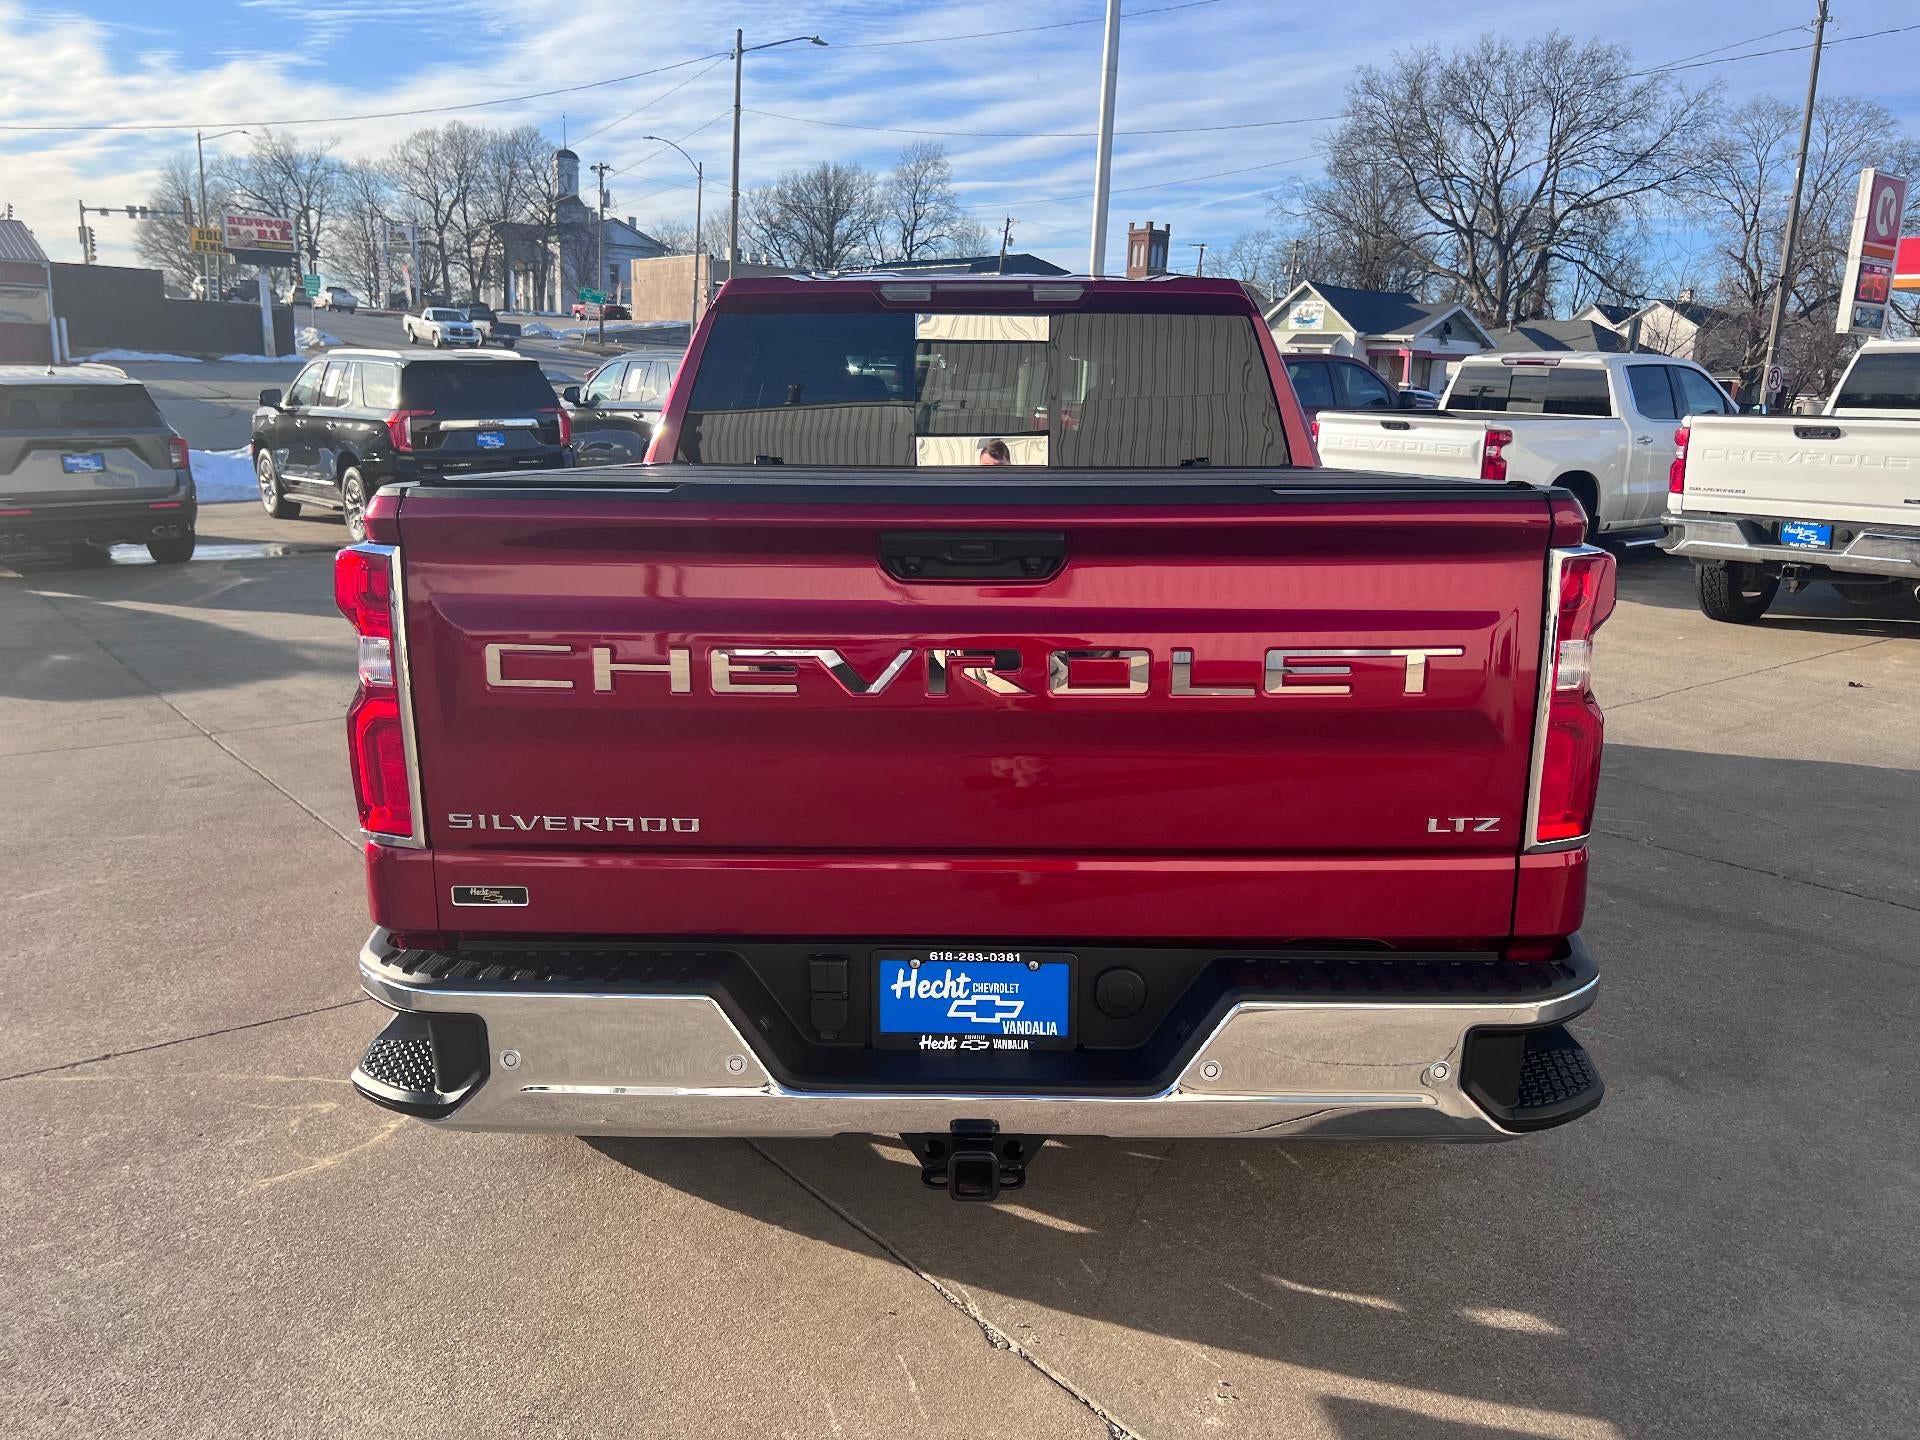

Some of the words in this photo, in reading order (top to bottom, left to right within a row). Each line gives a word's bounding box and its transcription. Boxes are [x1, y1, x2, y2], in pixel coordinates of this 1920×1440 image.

[227, 216, 292, 230] REDWOOD
[257, 228, 293, 241] BAR
[1325, 437, 1469, 456] CHEVROLET
[484, 644, 1465, 697] CHEVROLET
[448, 812, 701, 834] SILVERADO
[1426, 816, 1501, 834] LTZ
[929, 951, 1021, 962] 618-283-0381
[890, 968, 971, 999] Hecht
[972, 982, 1020, 994] CHEVROLET
[1002, 1020, 1058, 1036] VANDALIA
[919, 1035, 958, 1050] Hecht
[993, 1039, 1029, 1050] VANDALIA
